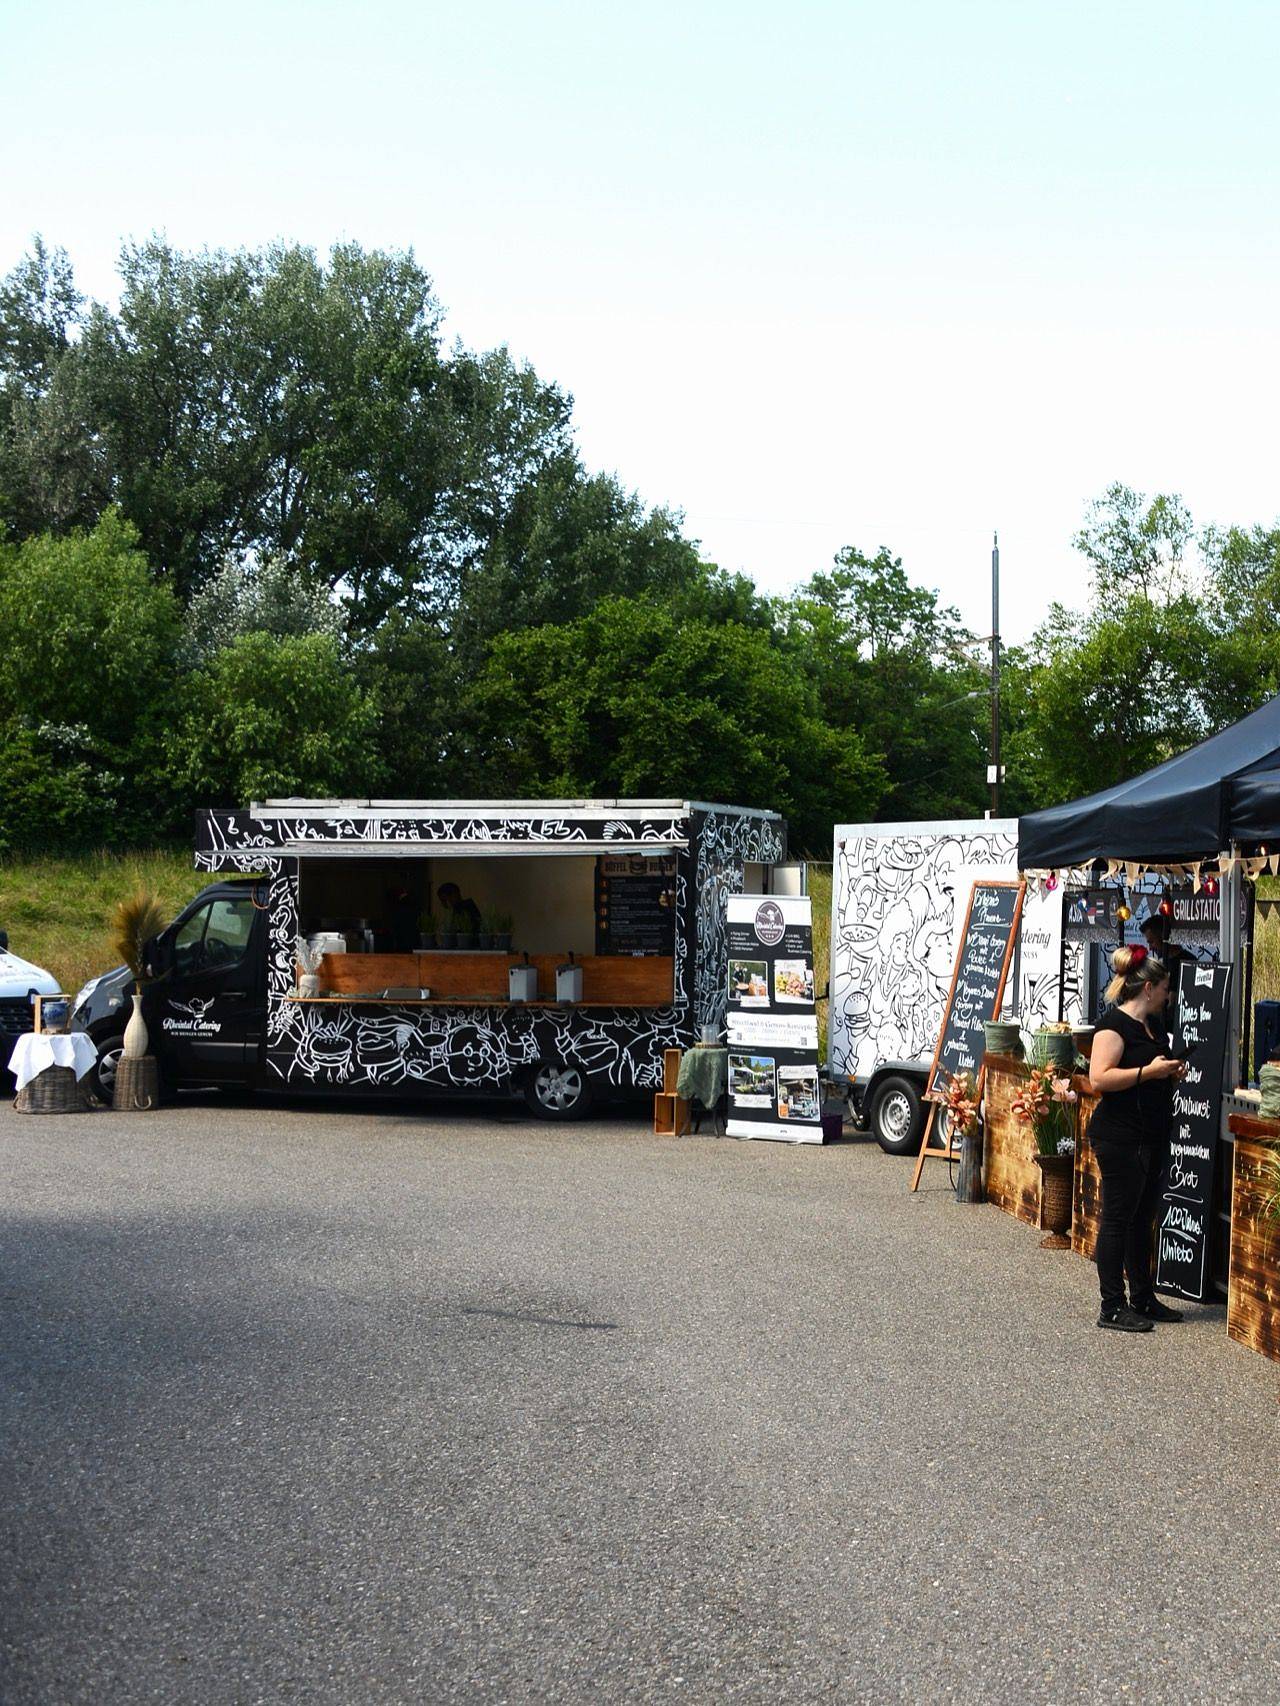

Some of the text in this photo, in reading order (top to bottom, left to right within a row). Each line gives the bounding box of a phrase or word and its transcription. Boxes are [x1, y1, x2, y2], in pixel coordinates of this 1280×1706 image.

[1173, 898, 1221, 921] GRILLSTATIO
[193, 1018, 222, 1033] Catering
[1168, 1163, 1199, 1189] Brot
